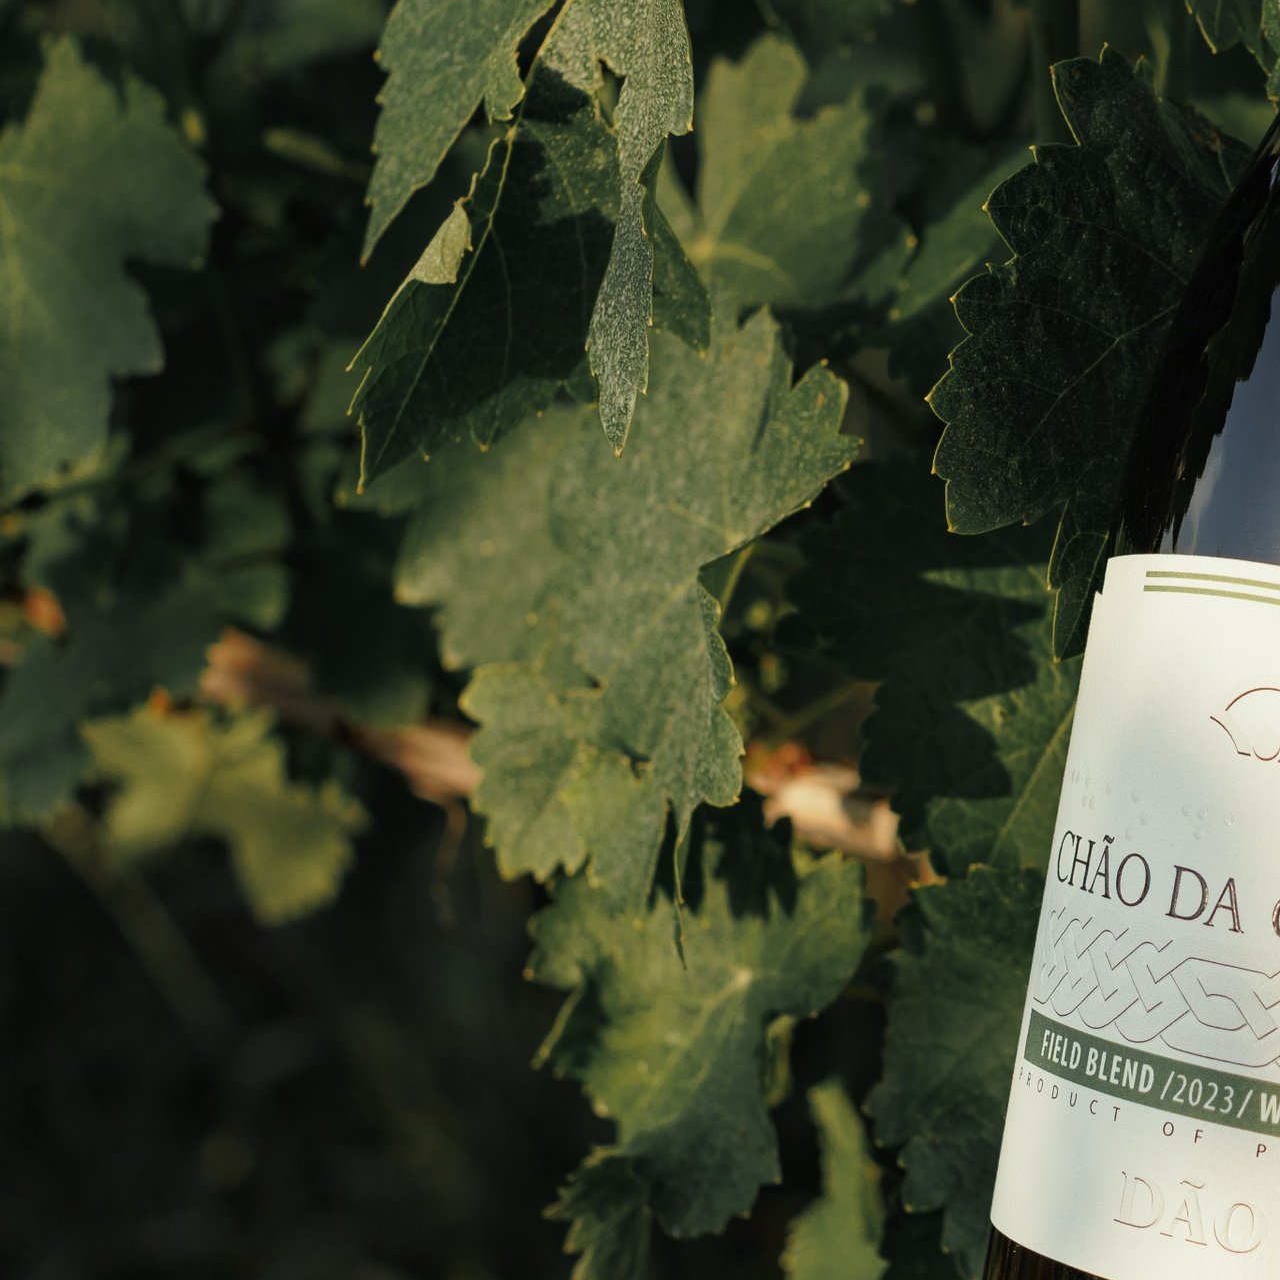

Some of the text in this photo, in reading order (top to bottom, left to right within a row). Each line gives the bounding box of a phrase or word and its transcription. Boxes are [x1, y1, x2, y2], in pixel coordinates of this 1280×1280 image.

[1057, 829, 1151, 907] CHÃO
[1165, 864, 1245, 934] DA
[1040, 1029, 1081, 1070] FIELD
[1085, 1047, 1155, 1093] BLEND
[1018, 1066, 1121, 1122] PRODUCT
[1162, 1121, 1204, 1144] OF
[1113, 1170, 1267, 1254] DÃO
